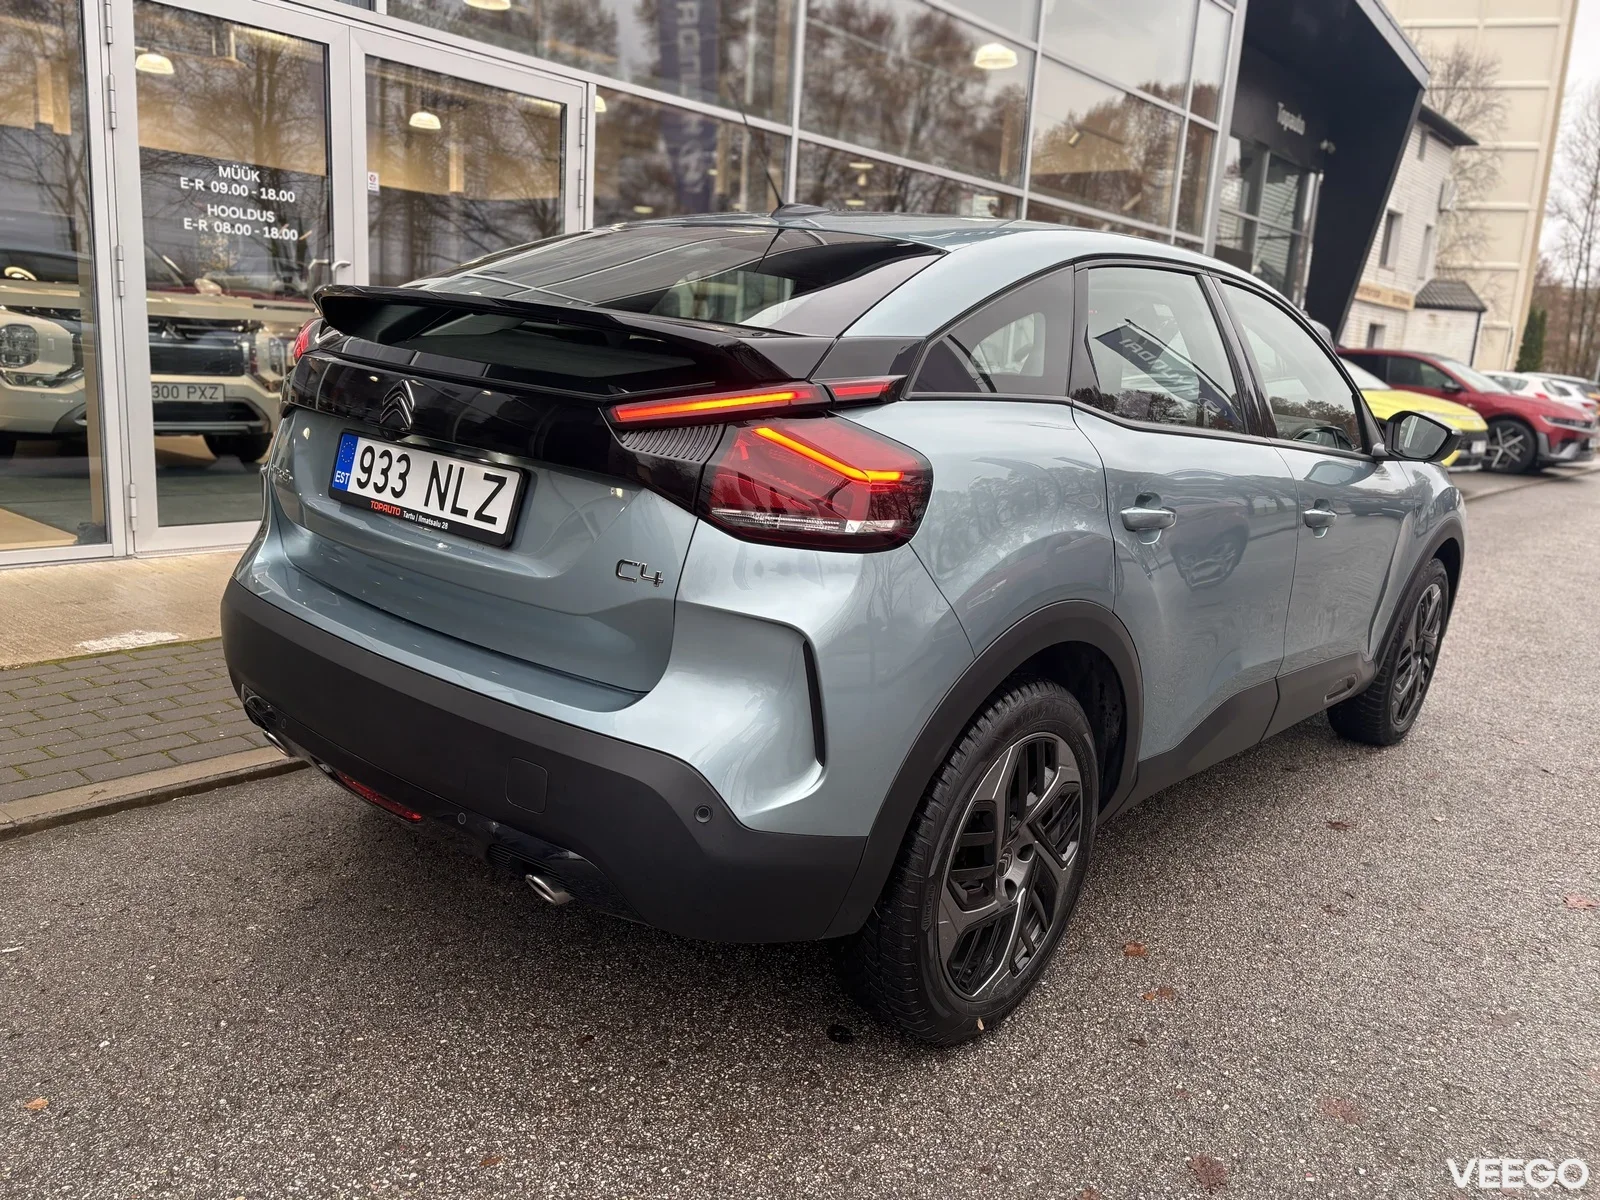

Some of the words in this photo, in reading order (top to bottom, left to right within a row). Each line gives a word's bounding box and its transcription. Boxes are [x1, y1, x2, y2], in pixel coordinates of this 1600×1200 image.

[218, 164, 261, 183] MÜÜK
[180, 177, 206, 191] E-R
[210, 181, 249, 197] 09.00
[260, 187, 295, 203] 18.00
[207, 204, 275, 223] HOOLDUS
[183, 217, 209, 232] E-R
[214, 221, 252, 236] 08.00
[263, 226, 298, 241] 18.00
[152, 385, 180, 399] 300
[187, 385, 219, 400] PXZ
[334, 470, 350, 485] EST
[356, 445, 411, 499] 933
[423, 460, 508, 525] NLZ
[370, 500, 401, 516] TOPAUTO
[403, 510, 415, 521] Tartu
[419, 515, 441, 528] Ilmatsalu
[441, 521, 449, 530] 28
[615, 558, 664, 588] C4
